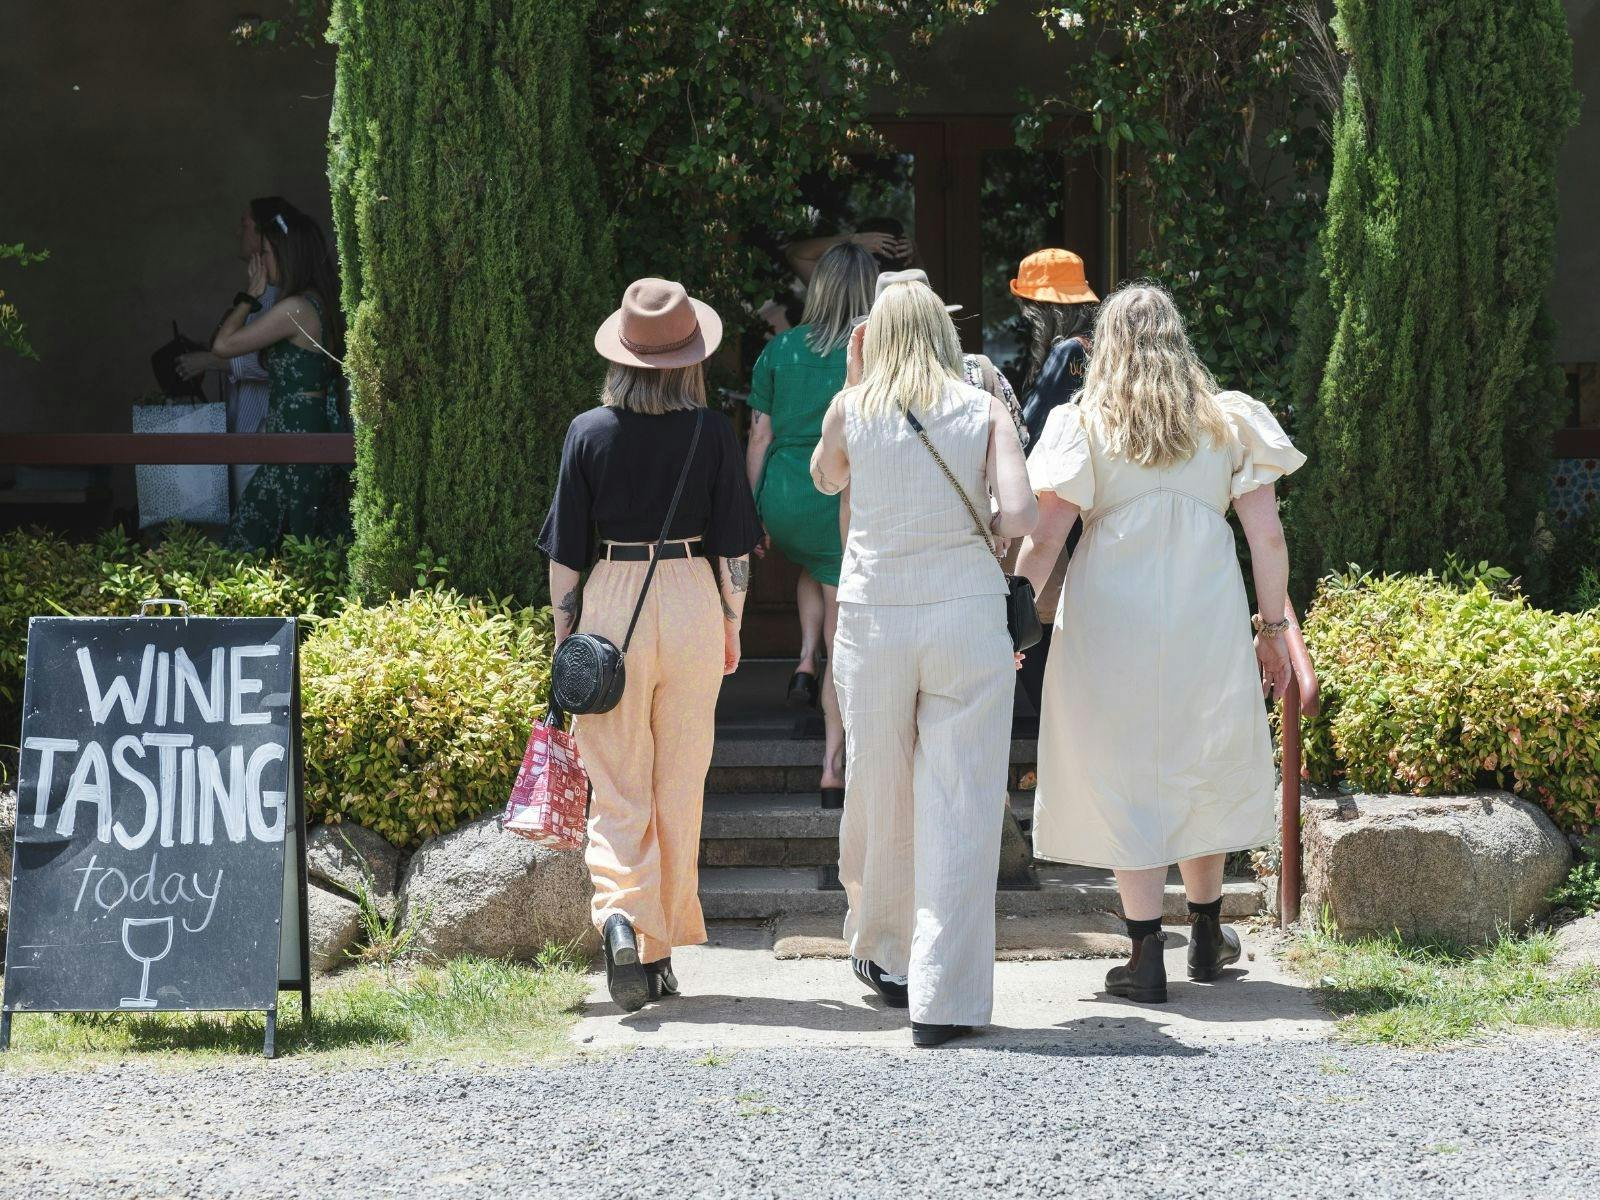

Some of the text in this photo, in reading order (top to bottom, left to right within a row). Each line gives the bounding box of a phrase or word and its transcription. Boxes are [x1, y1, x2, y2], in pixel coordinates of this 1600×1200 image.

[76, 644, 280, 726] WINE
[24, 733, 286, 850] TASTING
[74, 853, 223, 933] today
